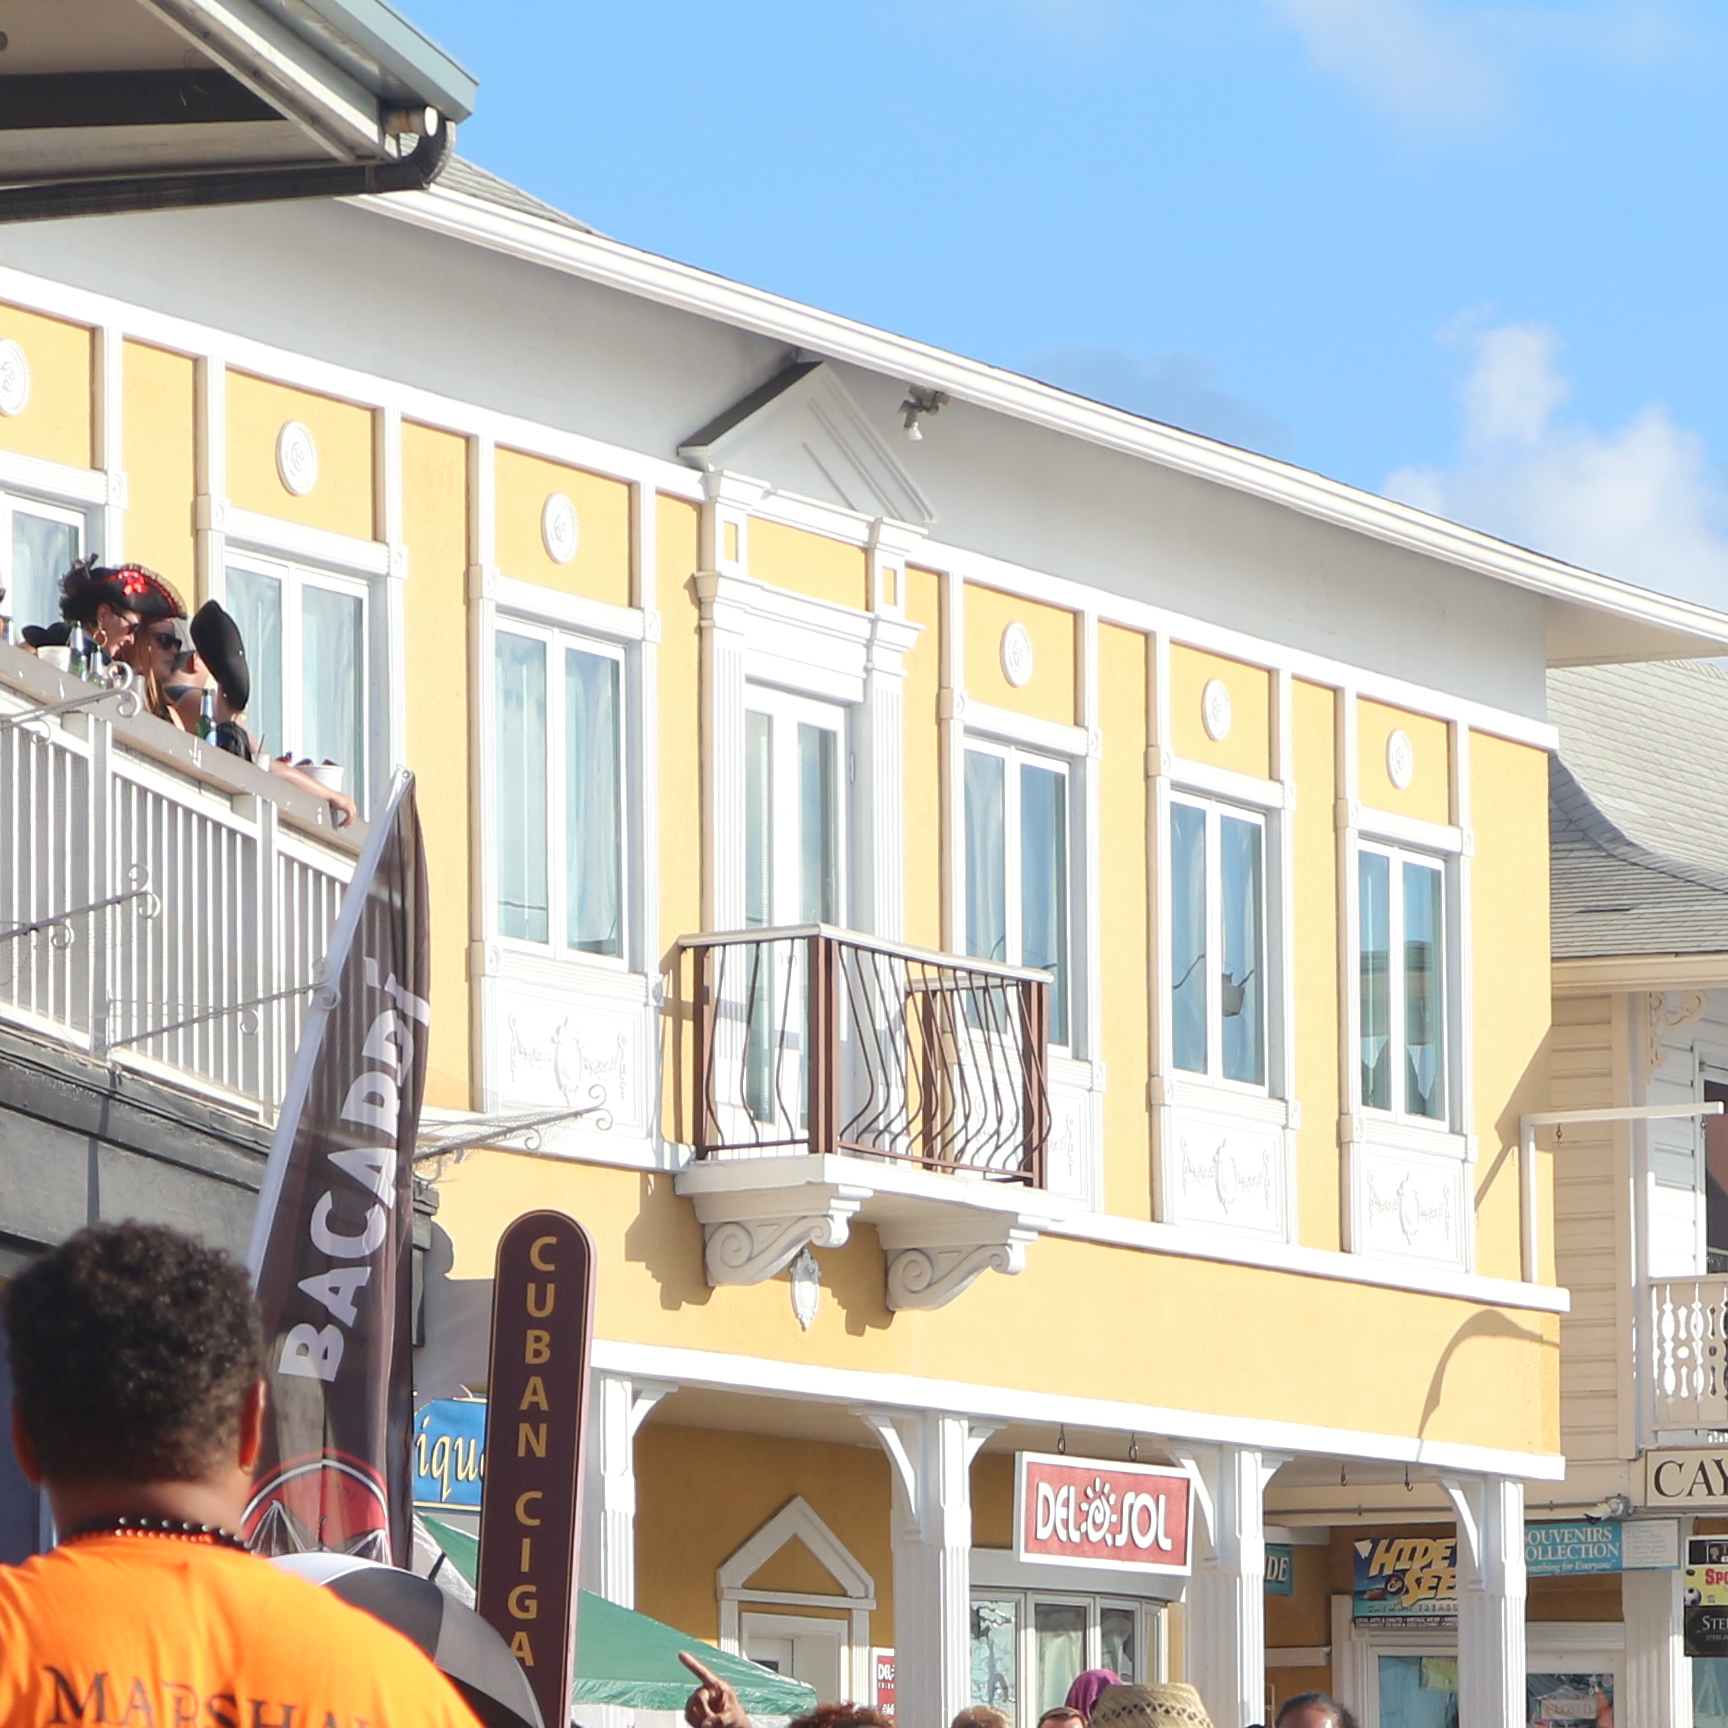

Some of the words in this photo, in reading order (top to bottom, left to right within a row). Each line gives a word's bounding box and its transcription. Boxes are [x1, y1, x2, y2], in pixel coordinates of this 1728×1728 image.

[516, 1235, 558, 1460] CUBAN
[1036, 1482, 1080, 1543] DEL
[1115, 1491, 1172, 1551] SOL
[1525, 1527, 1613, 1545] OUVENIRS
[1369, 1538, 1457, 1577] HIDE
[1526, 1543, 1620, 1561] OLLECTION
[506, 1490, 543, 1667] CIGA
[1401, 1568, 1457, 1608] SEE
